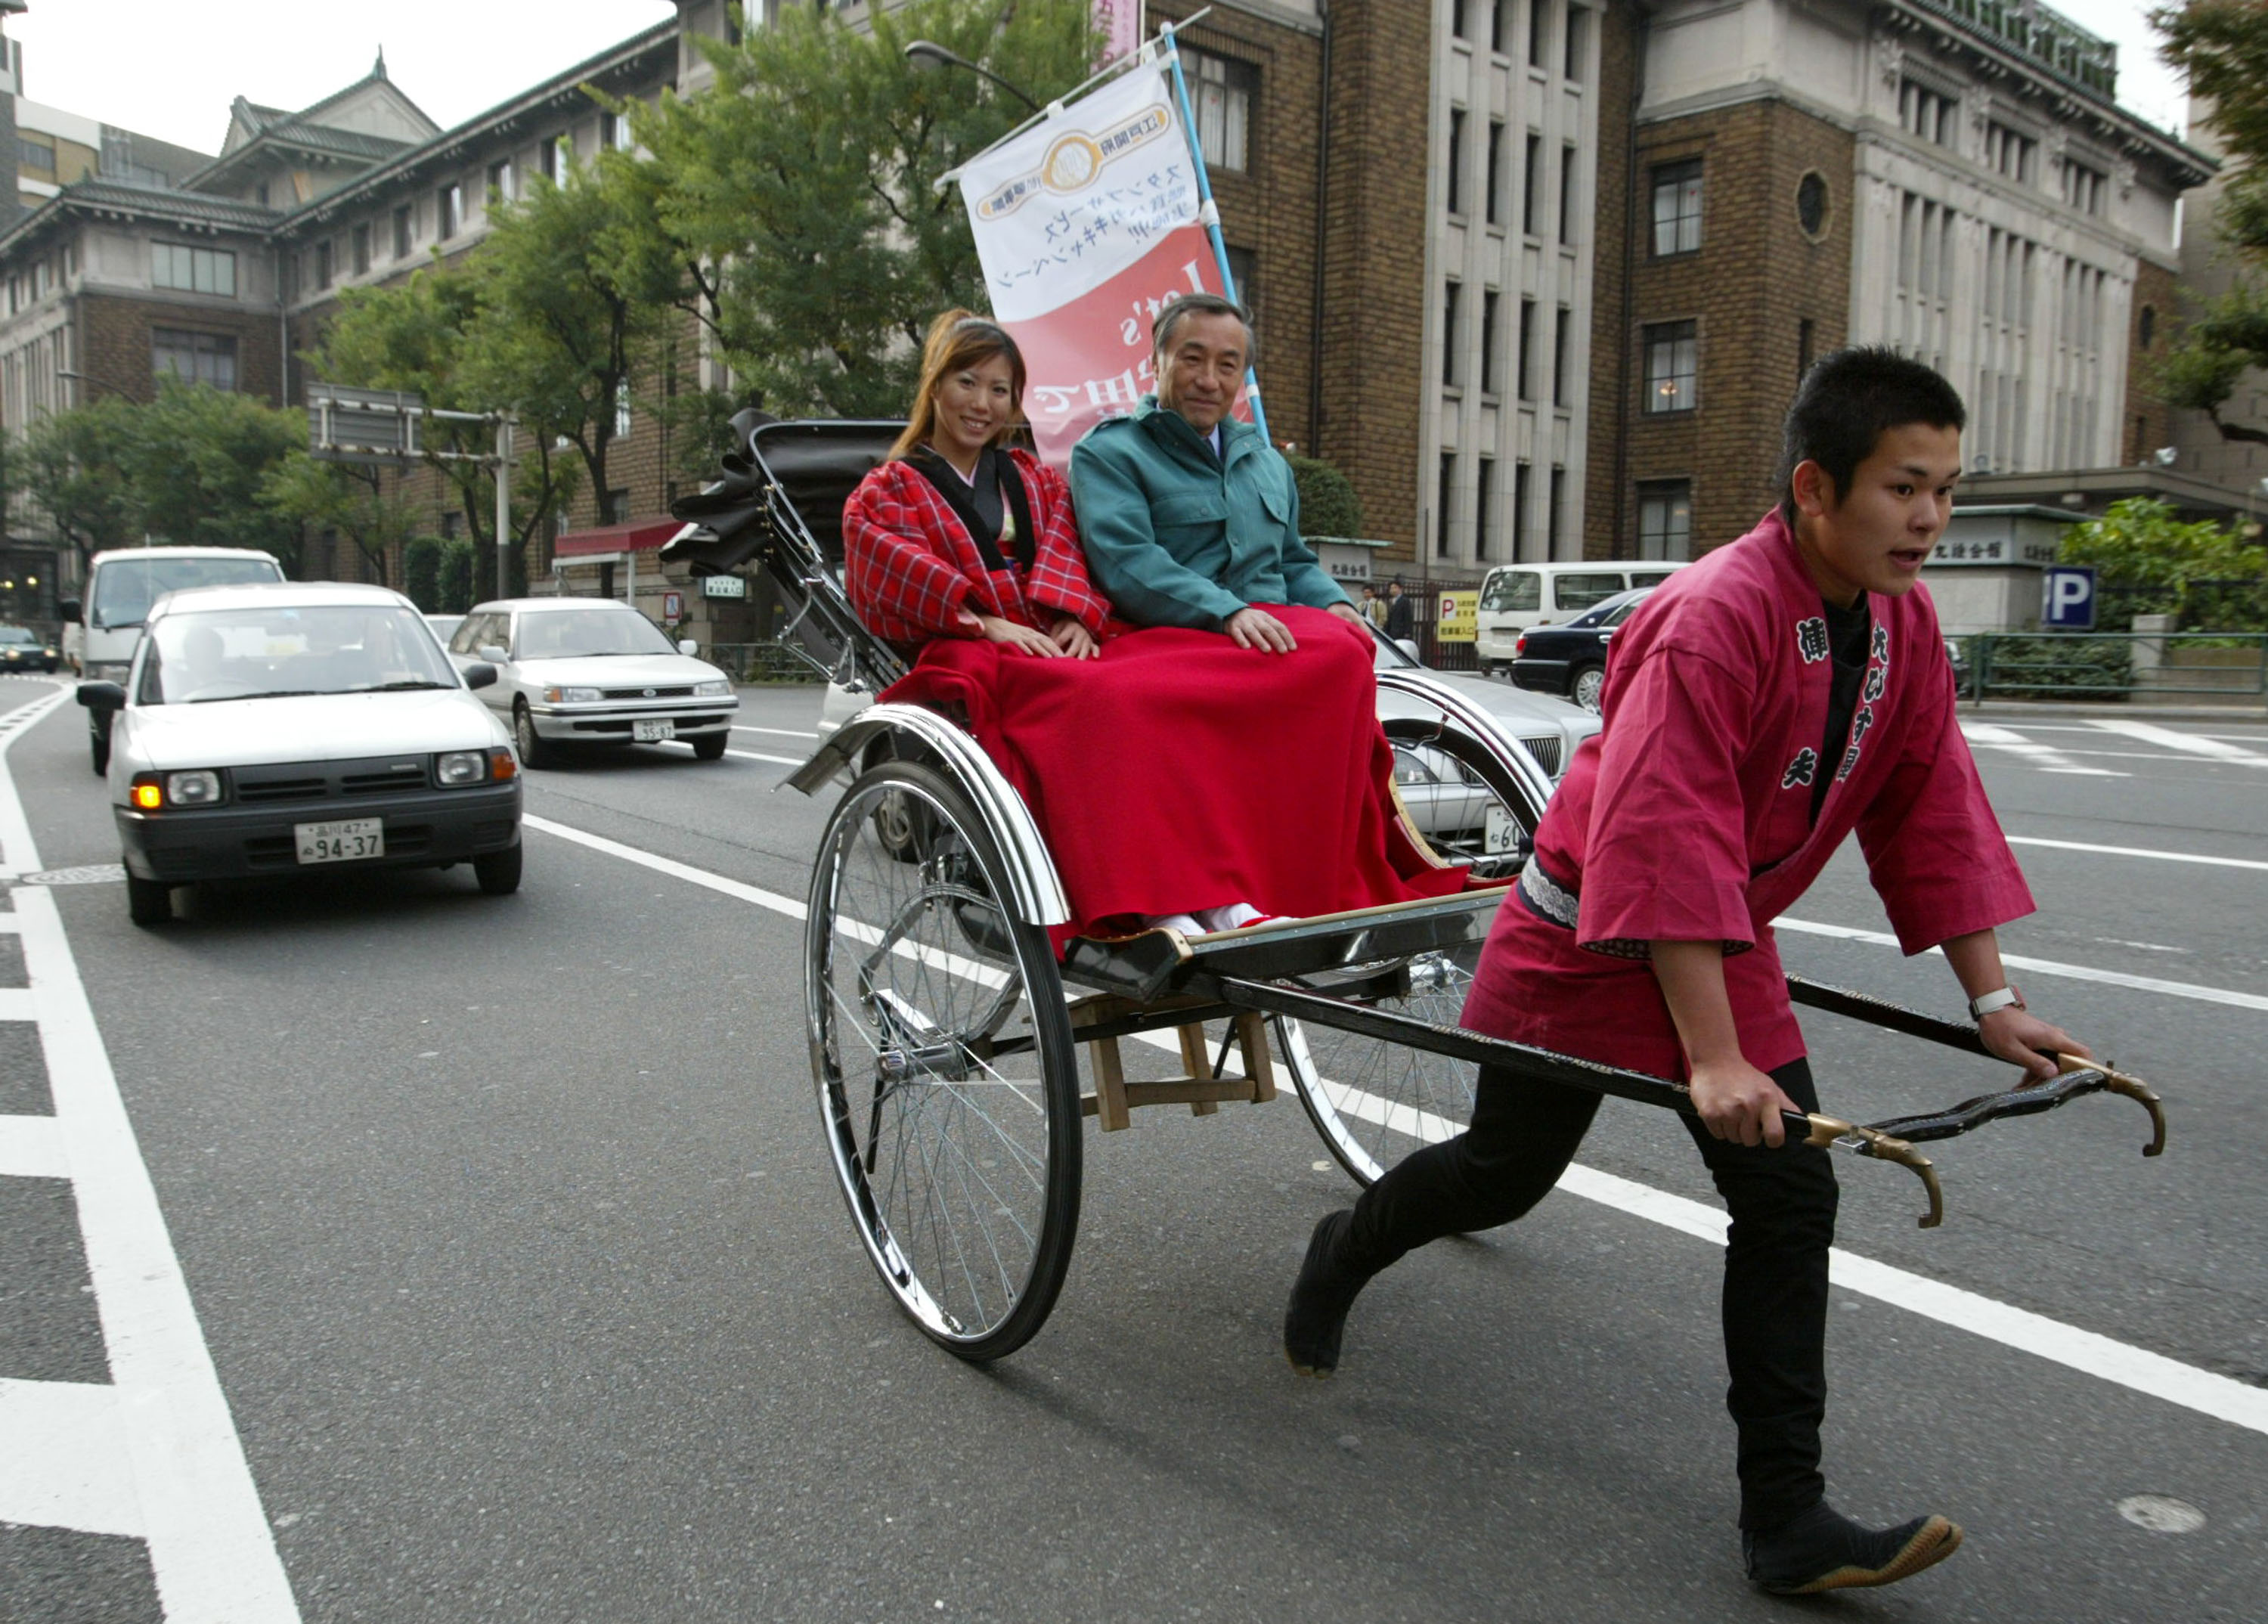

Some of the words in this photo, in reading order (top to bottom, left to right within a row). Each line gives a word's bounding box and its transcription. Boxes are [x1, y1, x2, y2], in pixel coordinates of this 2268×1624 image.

[1442, 599, 1455, 619] P
[2051, 572, 2090, 621] P
[316, 834, 379, 859] 94-37
